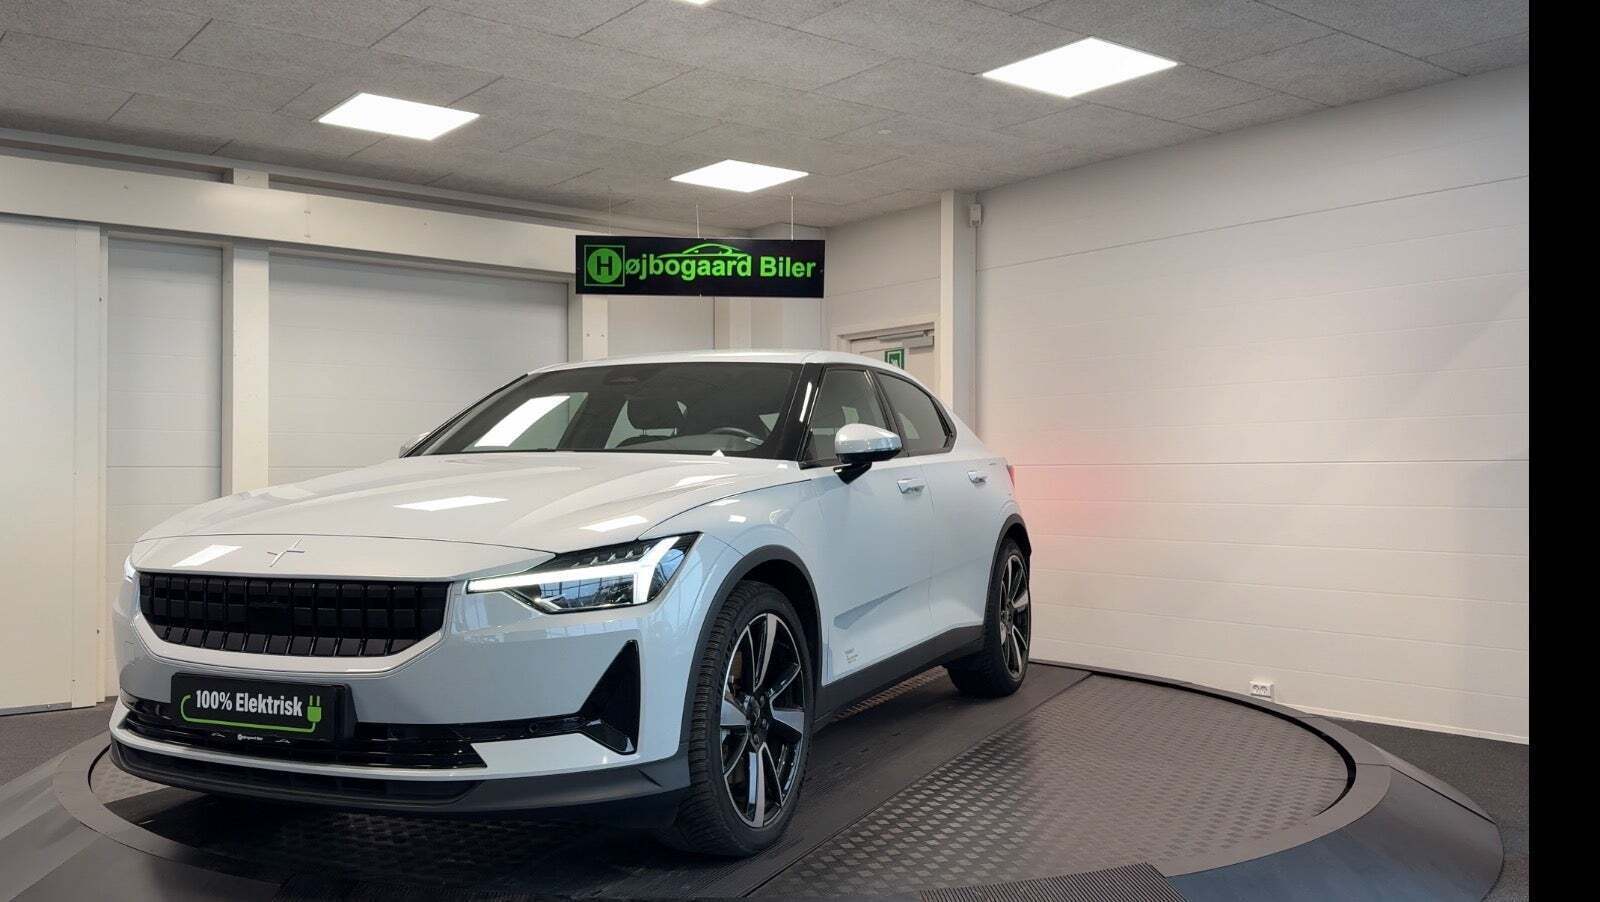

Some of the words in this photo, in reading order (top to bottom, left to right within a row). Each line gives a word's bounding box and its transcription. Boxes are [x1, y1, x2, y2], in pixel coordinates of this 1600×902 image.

[591, 253, 752, 281] Højbogaard
[760, 256, 816, 277] Biler
[196, 690, 232, 711] 100%
[235, 692, 303, 717] Elektrisk
